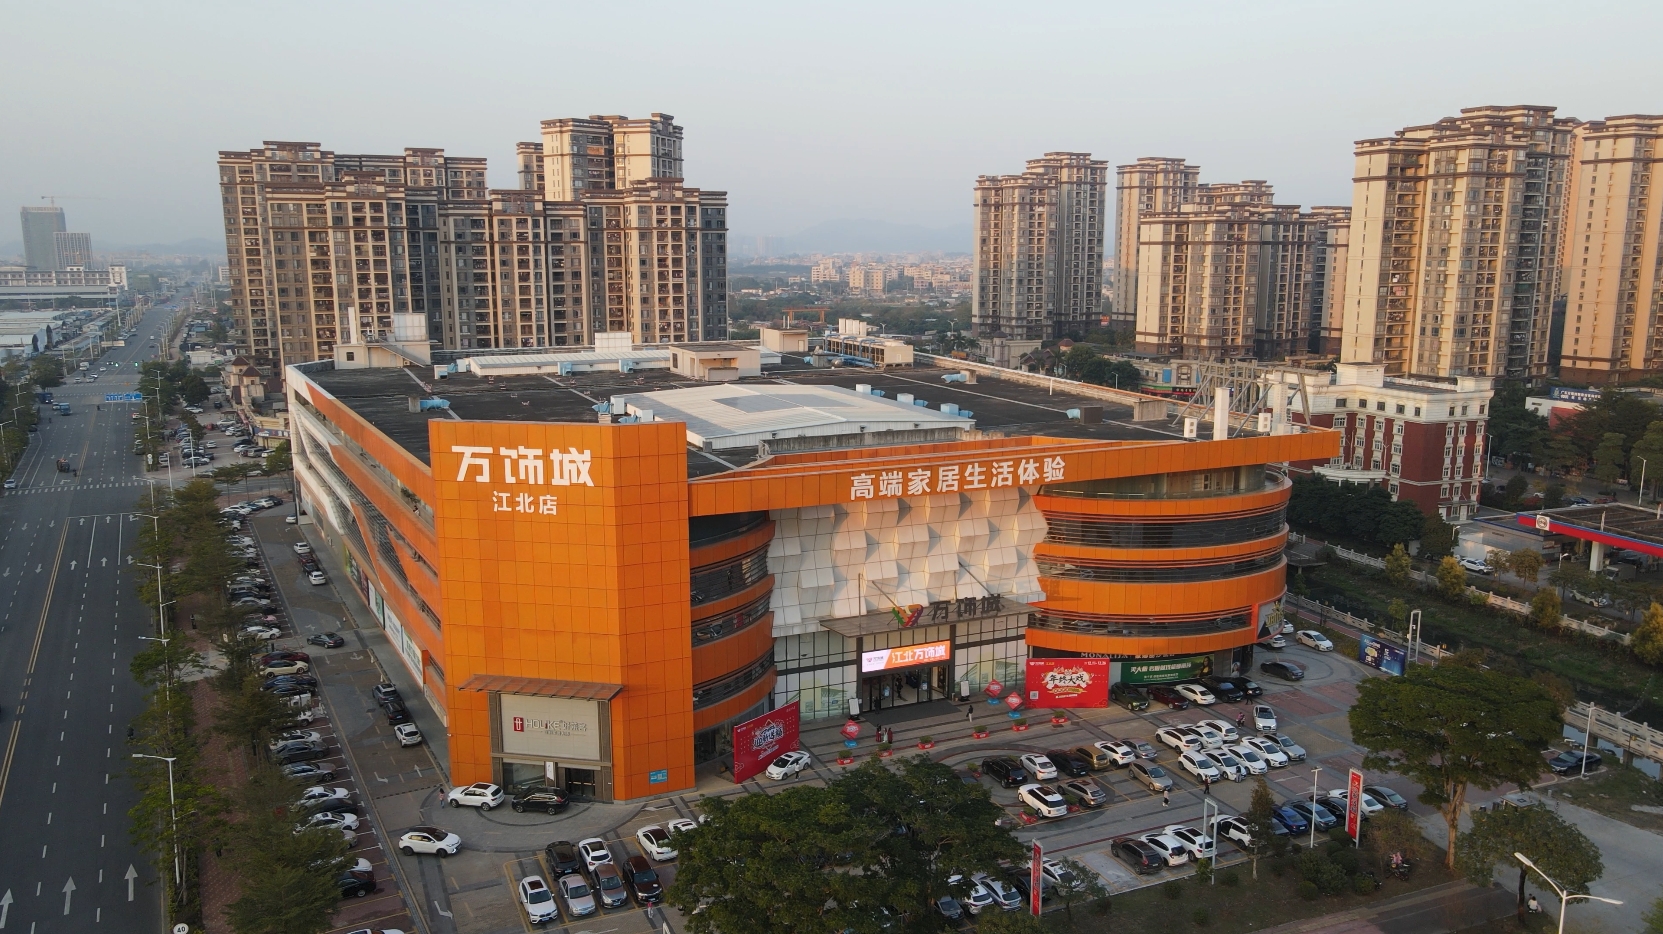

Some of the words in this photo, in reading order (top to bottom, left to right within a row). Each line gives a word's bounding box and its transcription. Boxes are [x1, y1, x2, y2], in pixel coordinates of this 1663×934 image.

[451, 445, 595, 487] 万饰城
[850, 455, 1066, 501] 高端家居生活体验
[492, 491, 558, 516] 江北店
[930, 593, 1005, 621] 万饰城
[891, 645, 946, 664] 江北万饰城
[1049, 673, 1086, 684] 年终大戏
